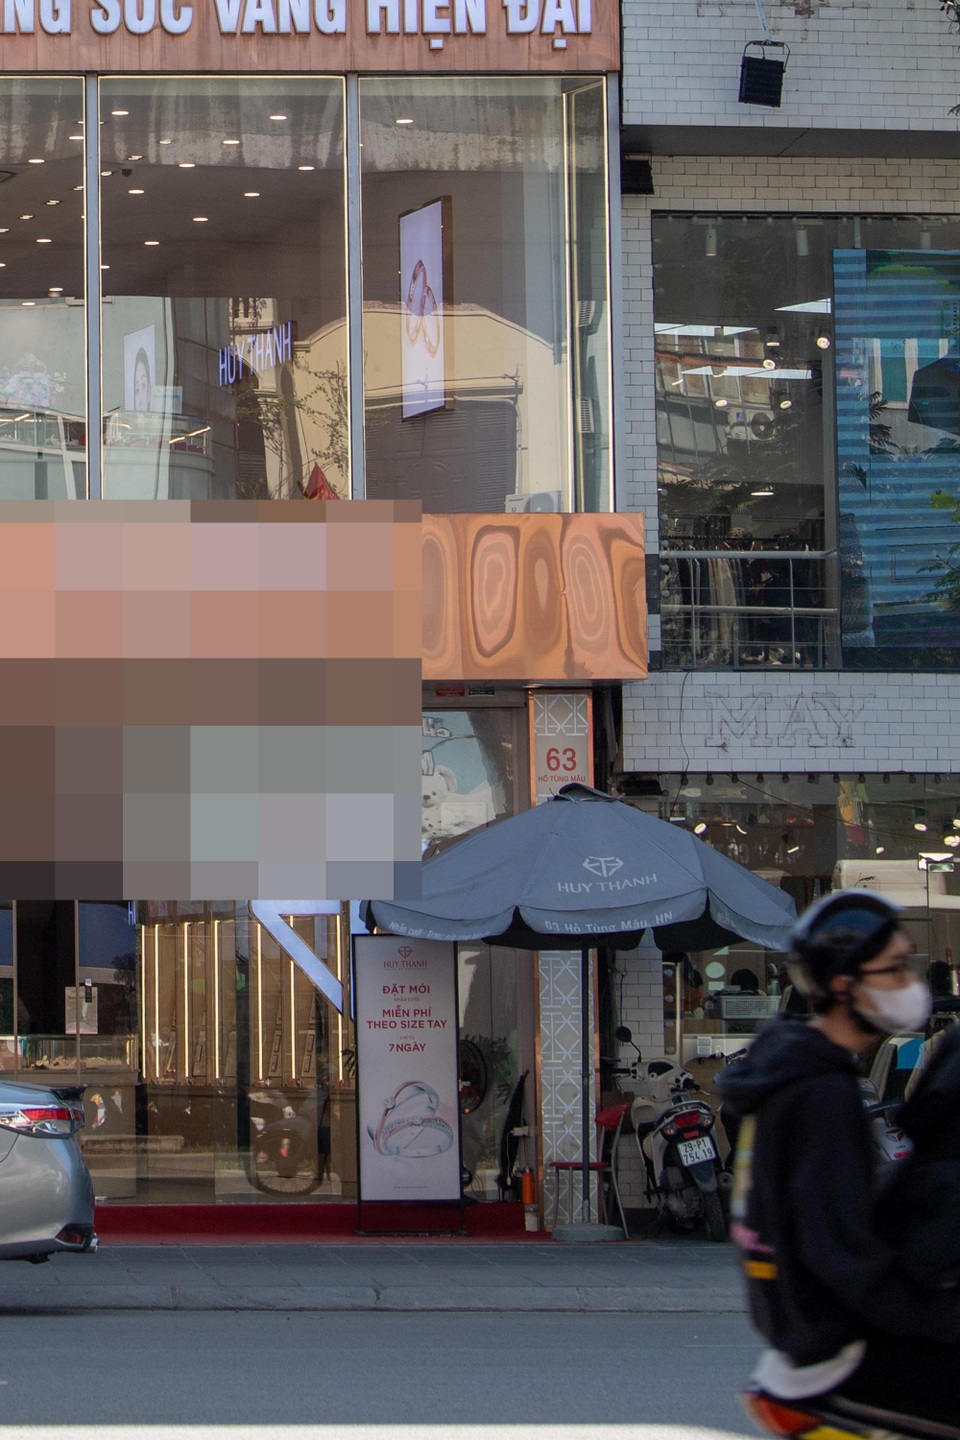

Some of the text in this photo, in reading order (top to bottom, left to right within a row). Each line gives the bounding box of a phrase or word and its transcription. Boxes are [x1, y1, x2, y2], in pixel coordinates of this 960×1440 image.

[219, 320, 292, 387] HUY THANH
[546, 747, 577, 772] 63
[557, 873, 657, 893] HUY THANH
[544, 920, 560, 932] 63
[655, 911, 673, 924] HN
[383, 960, 428, 968] HUY THANH
[382, 982, 430, 996] ĐẶT MỚI
[382, 1005, 432, 1018] MIỄN PHÍ
[366, 1019, 448, 1029] THEO SIZE TAY
[682, 1138, 707, 1153] 29-P1
[683, 1147, 713, 1164] 754.19
